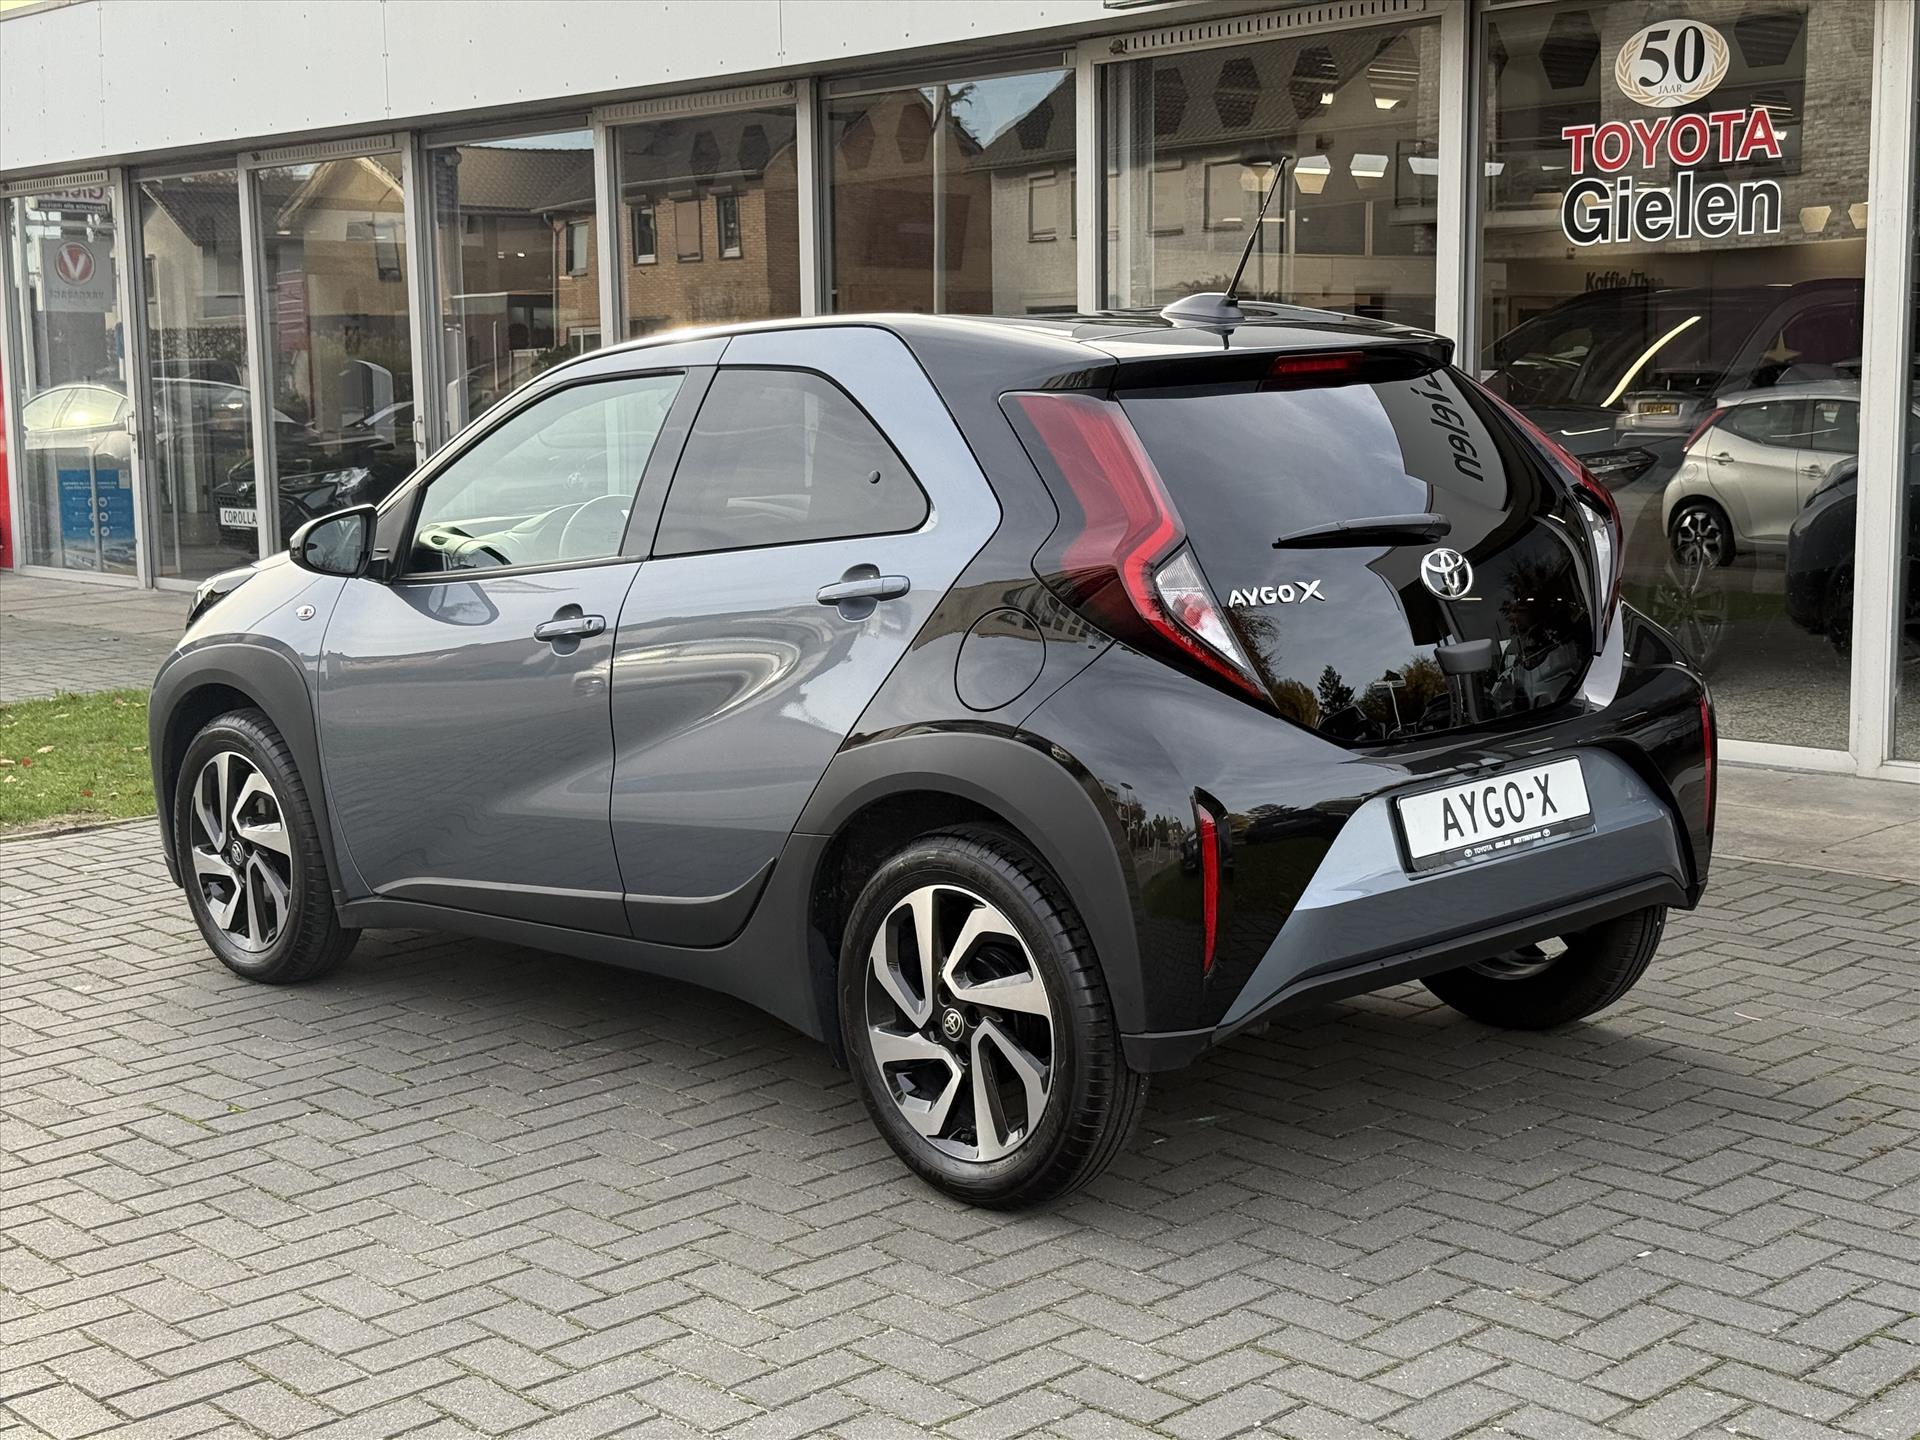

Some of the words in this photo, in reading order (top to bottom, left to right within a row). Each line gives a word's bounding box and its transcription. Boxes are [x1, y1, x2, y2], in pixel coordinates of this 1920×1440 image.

[1639, 26, 1705, 87] 50
[1658, 84, 1683, 95] JAAR
[1562, 107, 1783, 175] TOYOTA
[1561, 170, 1782, 246] Gielen
[224, 510, 257, 525] COROLLA
[1442, 774, 1557, 841] AYGO-X
